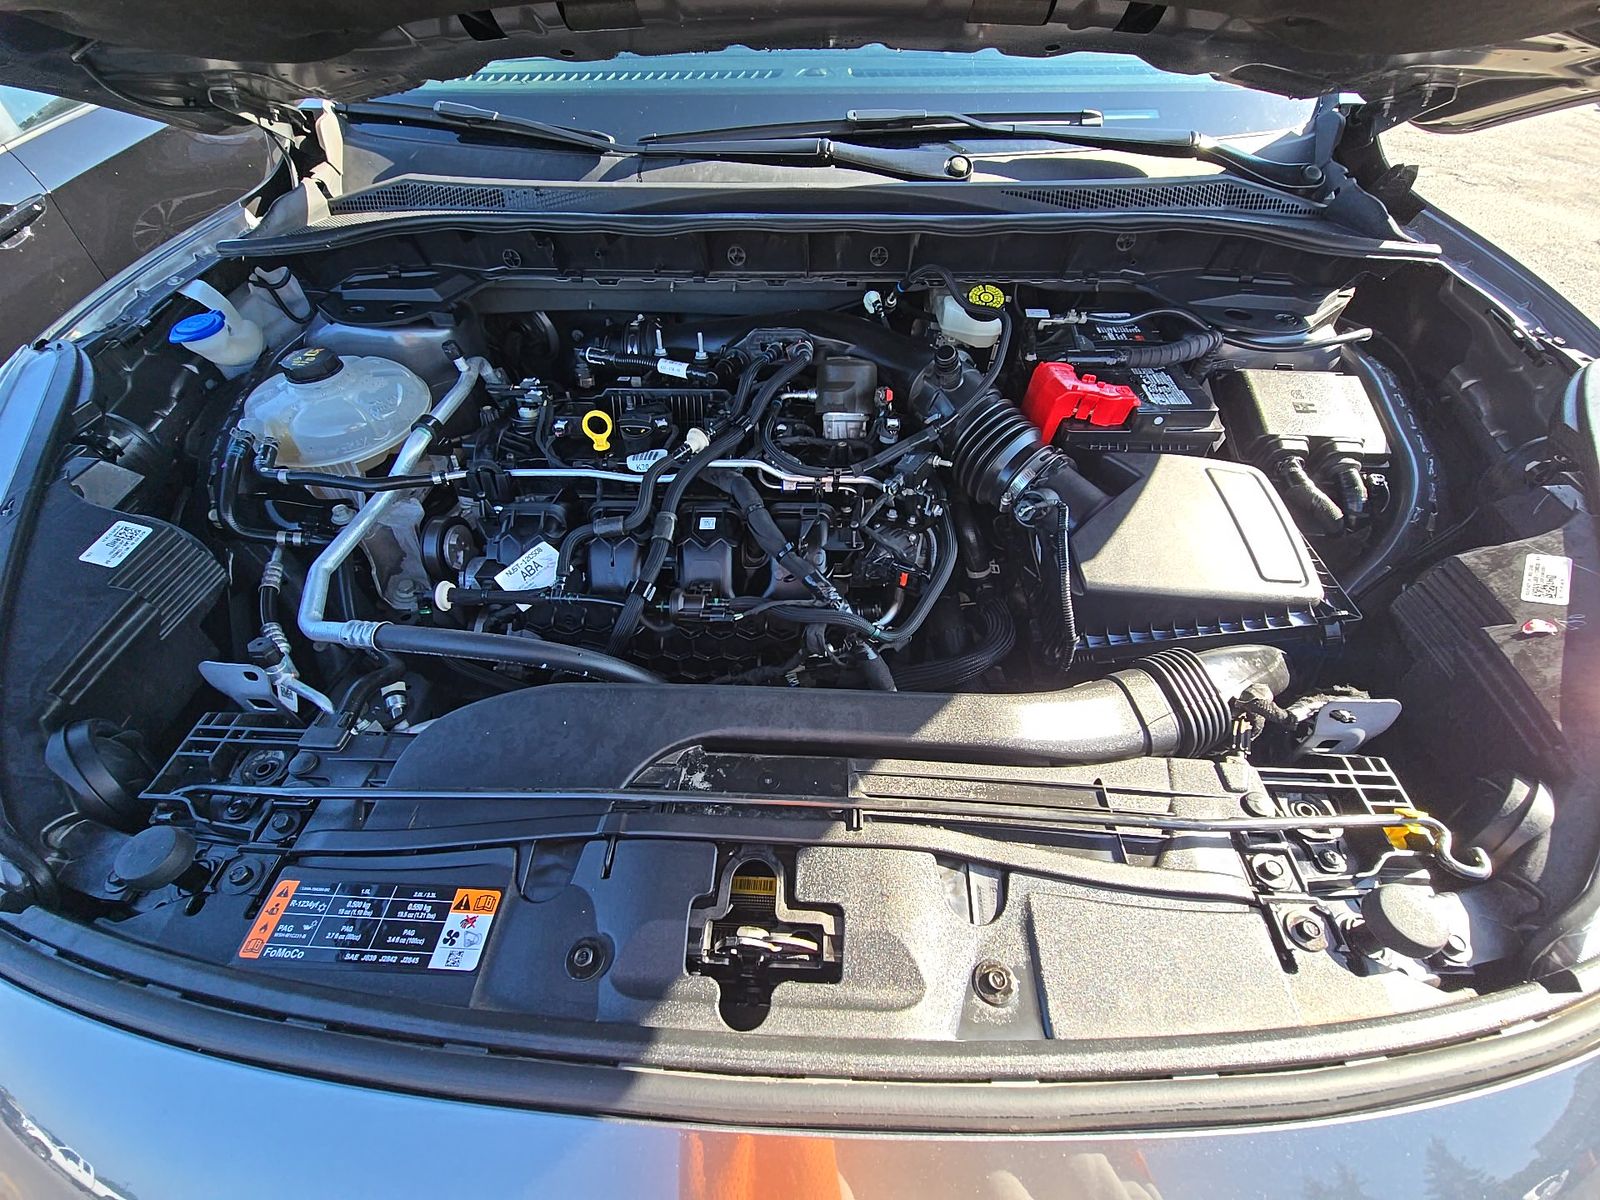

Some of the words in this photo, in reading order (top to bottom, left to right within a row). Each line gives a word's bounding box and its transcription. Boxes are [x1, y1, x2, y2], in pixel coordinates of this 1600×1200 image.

[520, 560, 543, 582] ABA
[290, 900, 319, 909] R-1234yf
[362, 902, 371, 910] kg
[423, 904, 432, 912] kg
[277, 924, 295, 932] PAG
[263, 947, 305, 959] FoMoCo
[344, 953, 360, 961] SAE
